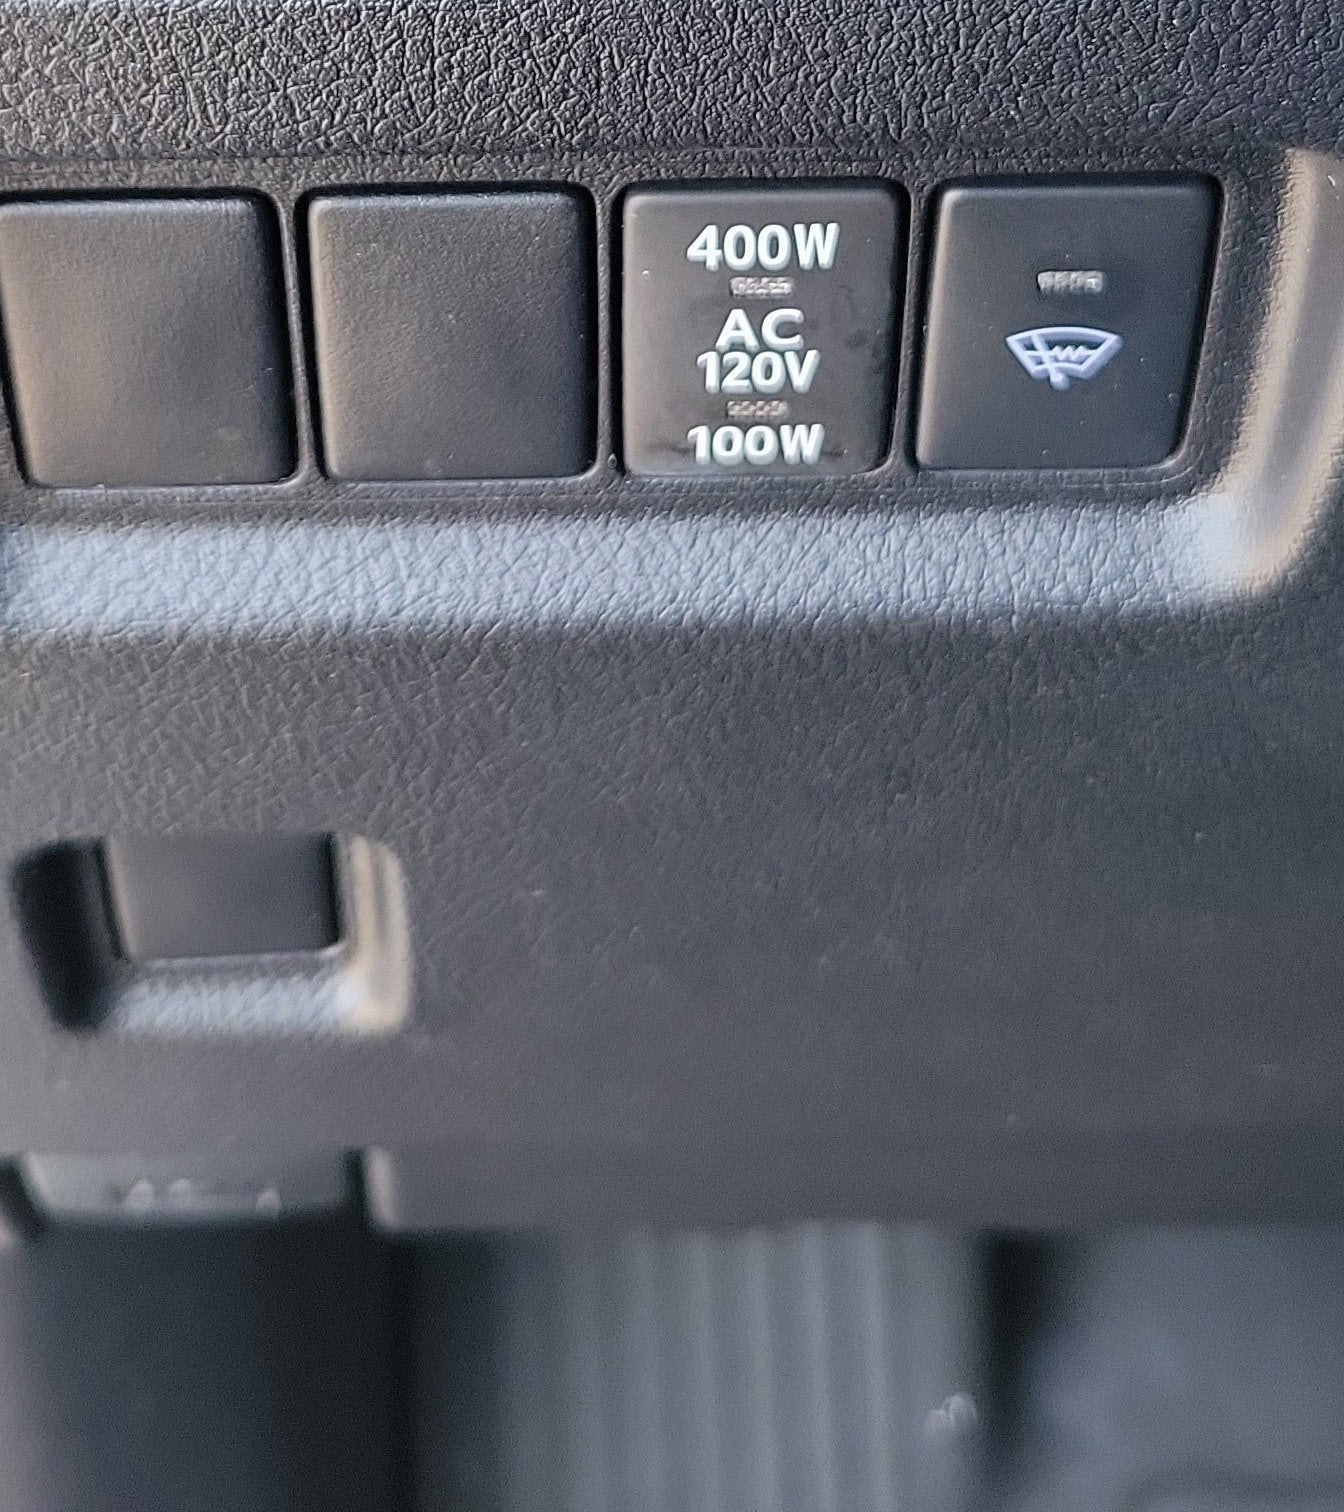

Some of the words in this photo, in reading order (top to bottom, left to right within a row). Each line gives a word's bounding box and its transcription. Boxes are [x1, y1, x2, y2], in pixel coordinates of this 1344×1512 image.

[687, 222, 840, 271] 400W
[715, 308, 805, 352] AC
[696, 349, 821, 394] 120V
[687, 423, 825, 467] 100W
